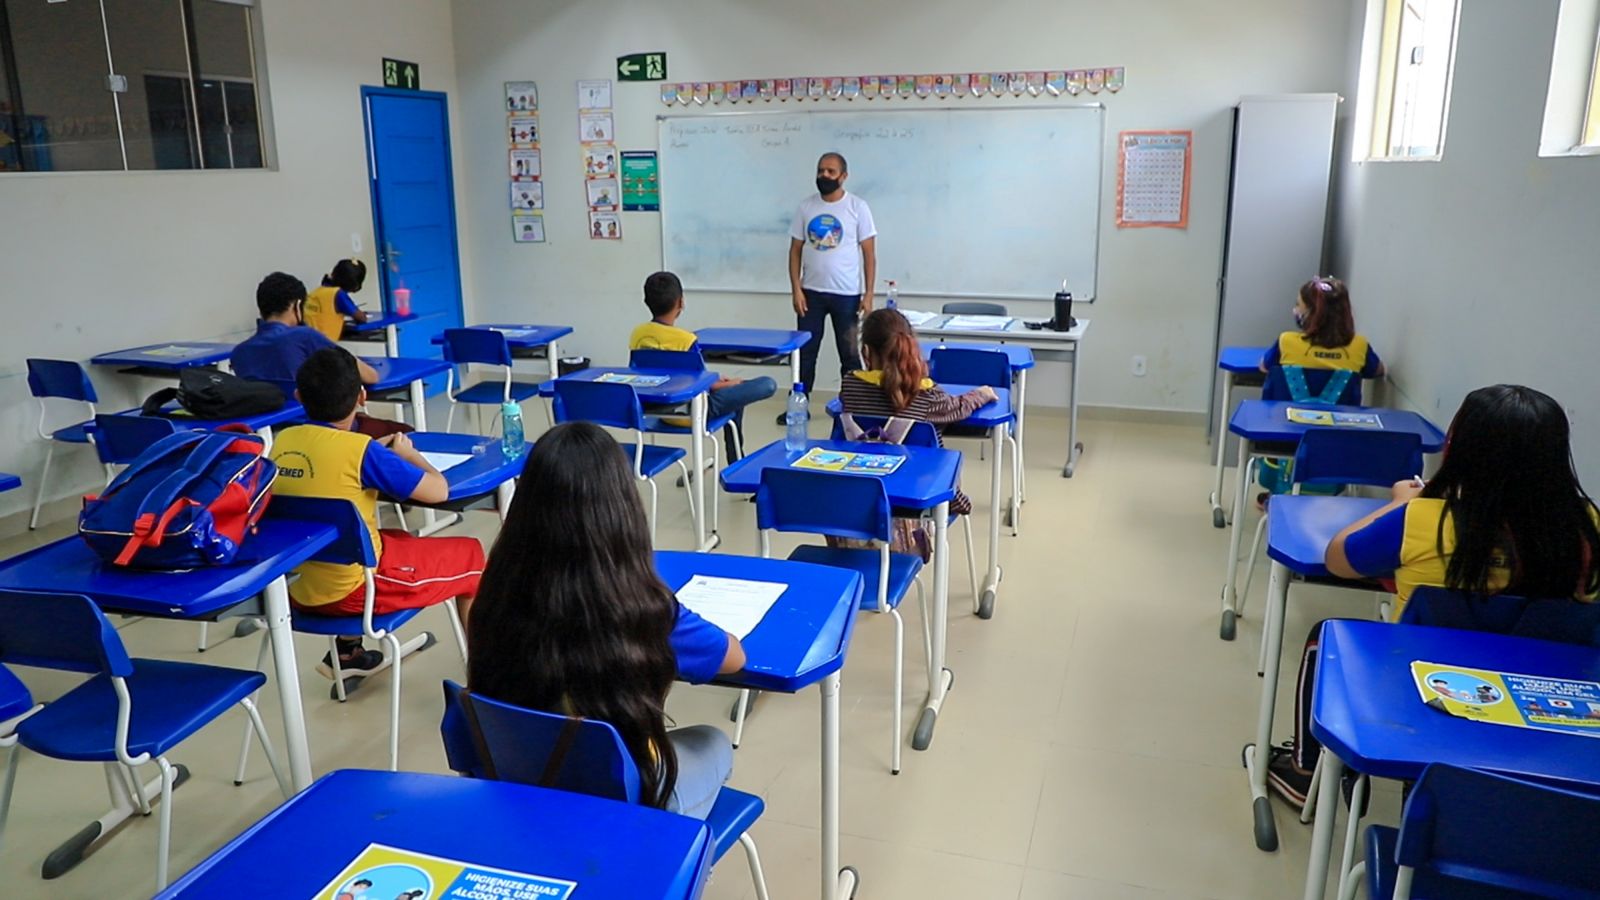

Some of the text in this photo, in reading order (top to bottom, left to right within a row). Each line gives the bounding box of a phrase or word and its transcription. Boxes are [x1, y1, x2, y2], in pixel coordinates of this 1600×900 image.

[1314, 352, 1342, 360] SEMED
[465, 873, 560, 896] HIGIENIZE SUAS
[513, 890, 540, 900] USE
